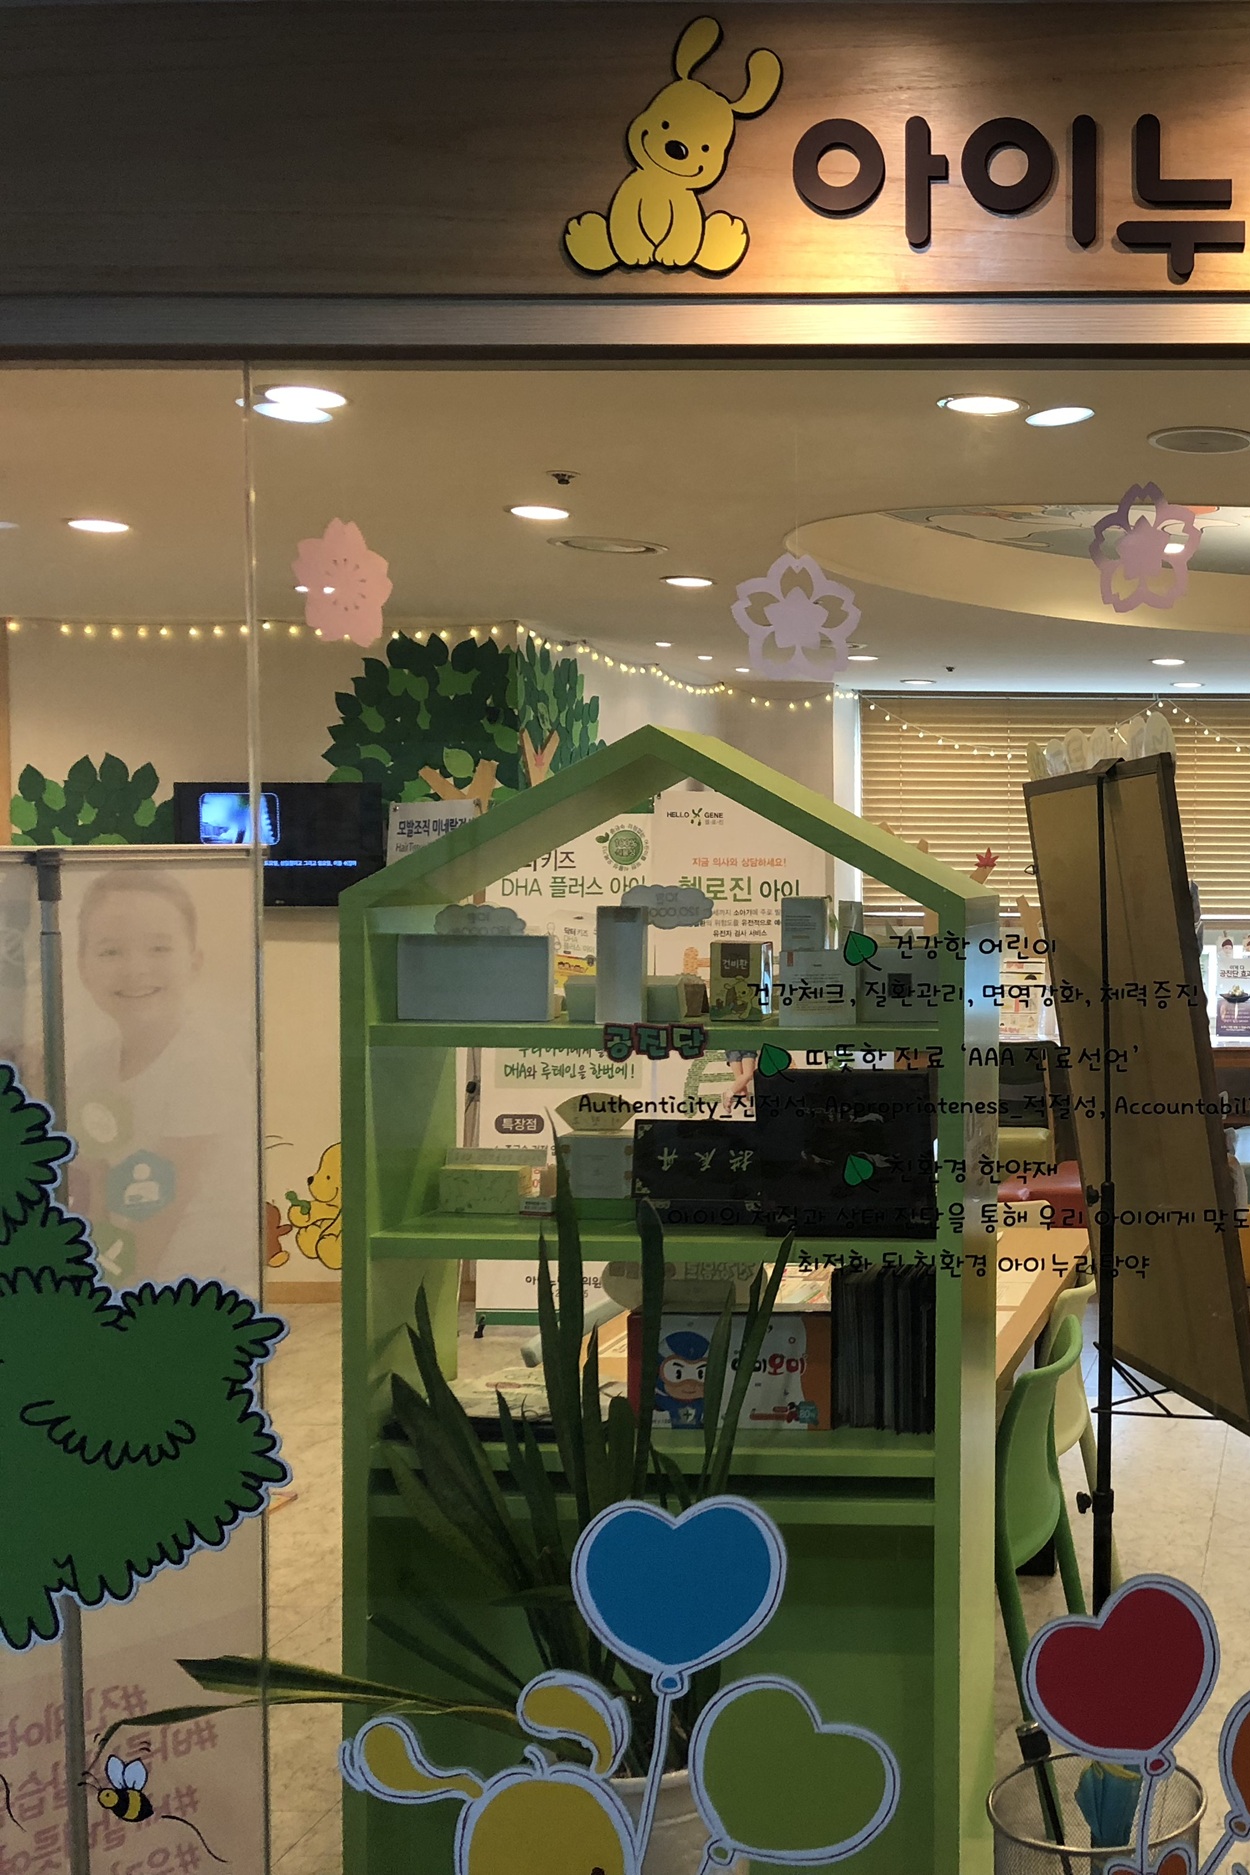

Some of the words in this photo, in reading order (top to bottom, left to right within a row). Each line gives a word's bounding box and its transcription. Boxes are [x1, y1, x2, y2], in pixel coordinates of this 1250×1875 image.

[666, 811, 690, 819] HELLO
[396, 819, 431, 837] 모발조직
[692, 857, 710, 867] 지금
[712, 857, 739, 867] 의사와
[741, 857, 787, 868] 상담하세요!
[501, 878, 543, 897] DHA
[549, 876, 604, 898] 플러스
[759, 879, 801, 902] 아이
[889, 931, 971, 961] 건강한
[978, 933, 1056, 961] 어린이
[721, 957, 748, 971] 건비환
[747, 979, 857, 1007] 건강체크,
[864, 979, 974, 1008] 질환관리,
[982, 979, 1091, 1008] 면역강화,
[1099, 980, 1199, 1009] 체력증진
[605, 1024, 707, 1061] 공진단
[806, 1042, 888, 1073] 따뜻한
[895, 1046, 945, 1071] 진료
[504, 1062, 537, 1080] DHA와
[541, 1062, 587, 1080] 루테인을
[501, 1118, 537, 1131] 특장점
[889, 1153, 967, 1184] 친환경
[978, 1154, 1059, 1186] 한약재
[836, 1206, 885, 1230] 상태
[895, 1202, 965, 1234] 진단을
[981, 1202, 1028, 1234] 통해
[1039, 1202, 1083, 1231] 우리
[1094, 1204, 1195, 1227] 아이에게
[798, 1249, 873, 1274] 최적화
[913, 1248, 986, 1278] 친환경
